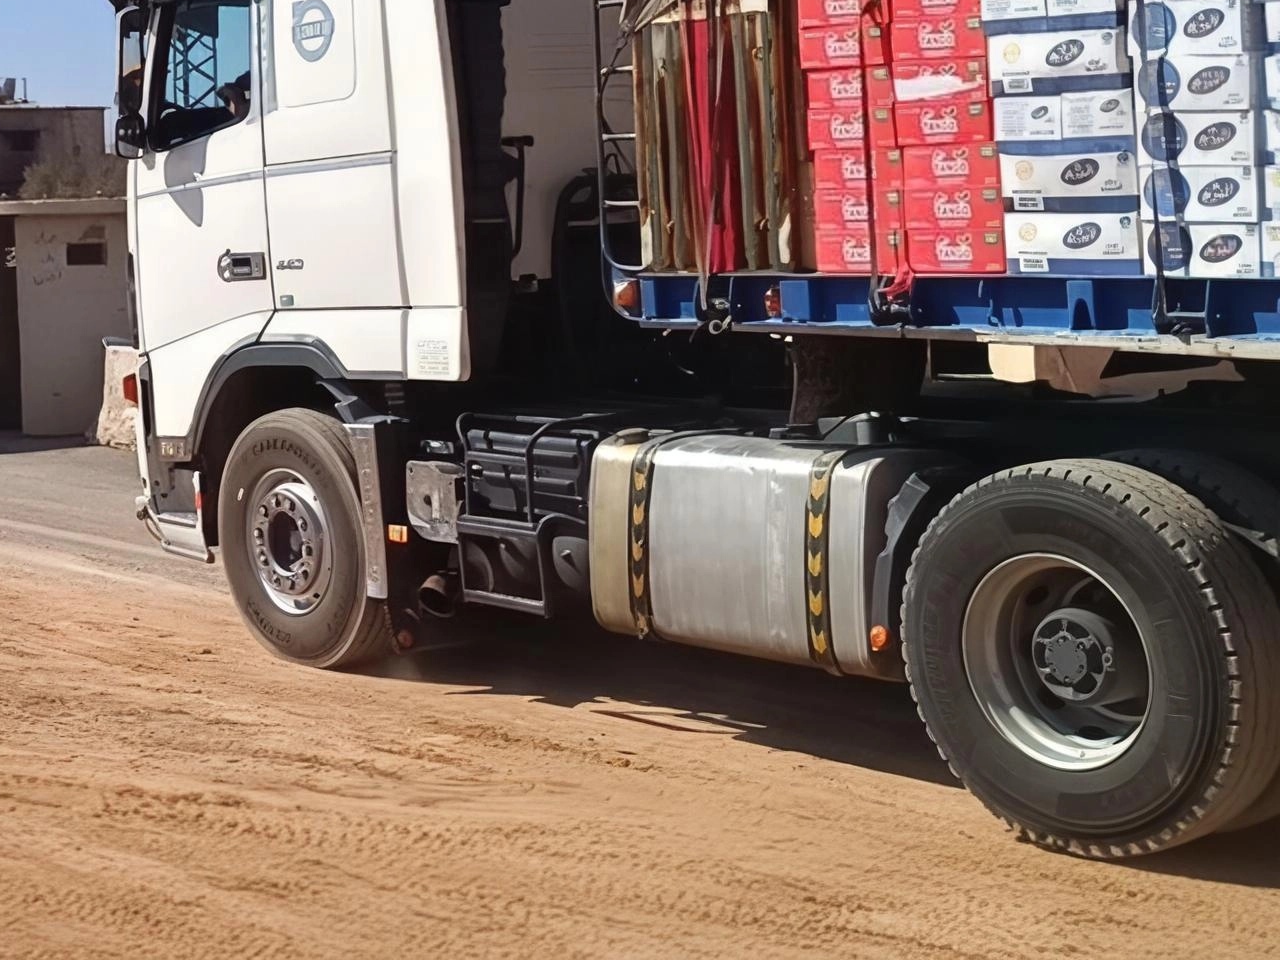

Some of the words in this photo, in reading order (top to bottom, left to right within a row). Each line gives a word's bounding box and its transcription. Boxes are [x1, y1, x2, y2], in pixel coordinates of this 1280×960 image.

[827, 2, 858, 13] TANGO
[922, 34, 953, 45] TANGO
[923, 121, 955, 131] TANGO
[935, 163, 967, 173] TANGO
[937, 206, 969, 216] TANGO
[939, 248, 970, 258] TANGO
